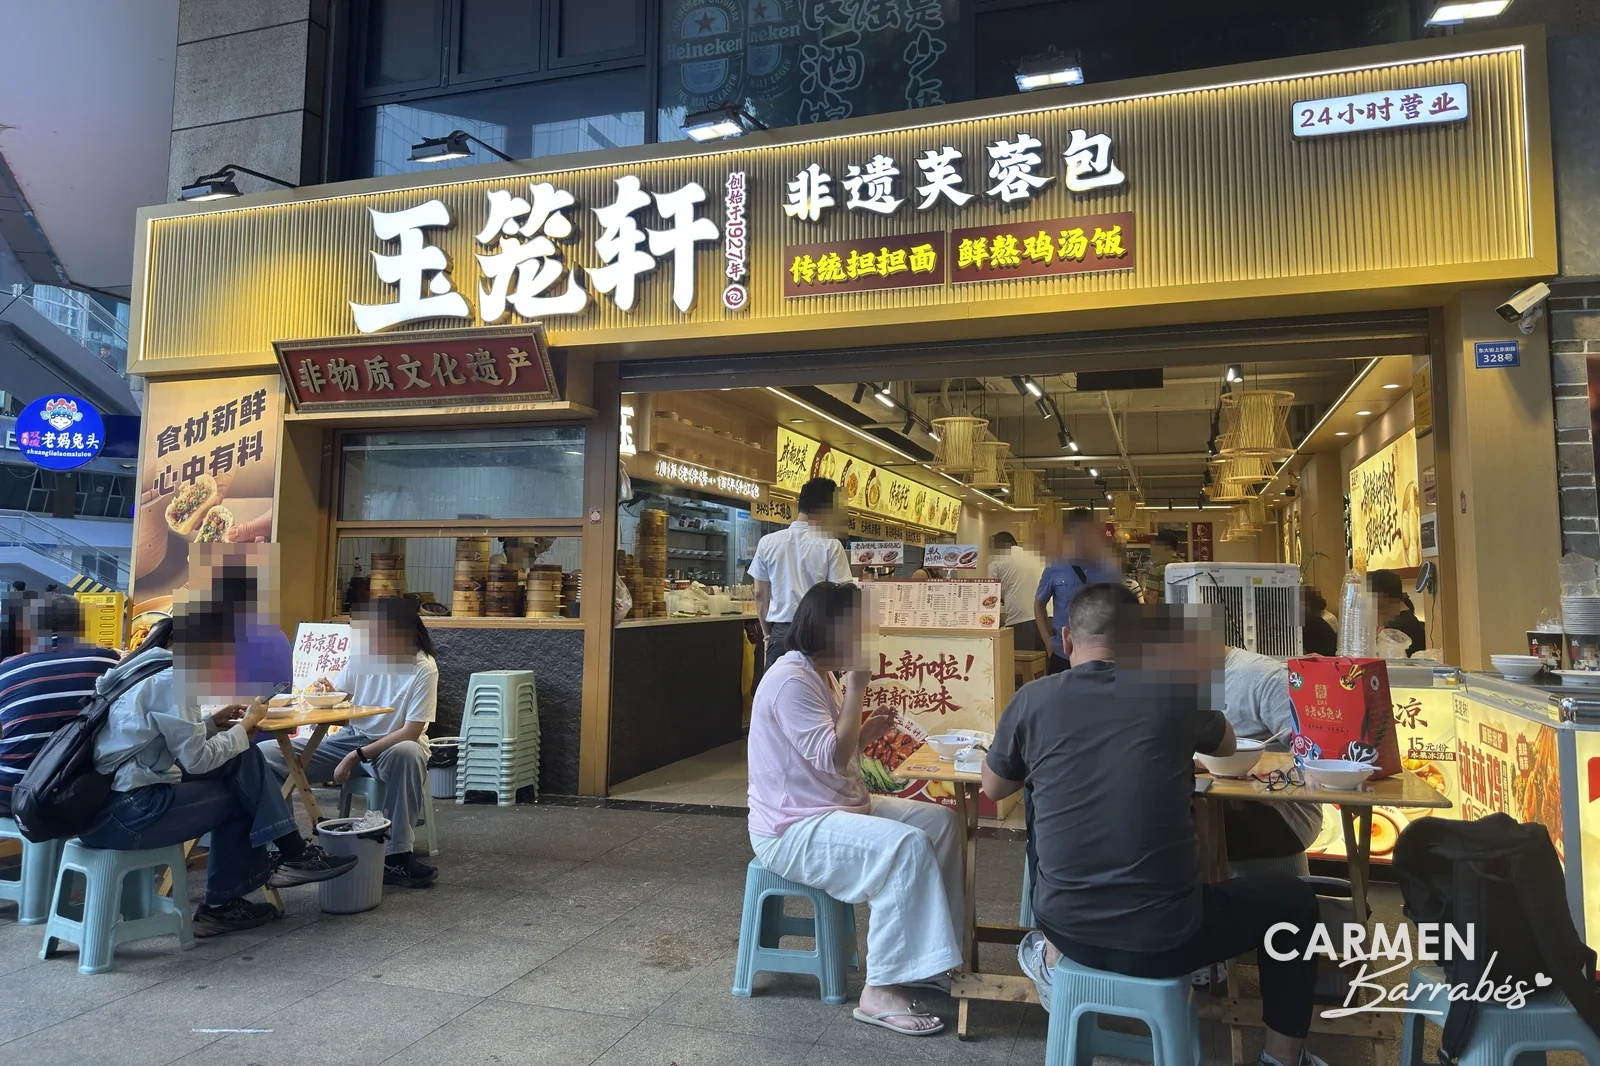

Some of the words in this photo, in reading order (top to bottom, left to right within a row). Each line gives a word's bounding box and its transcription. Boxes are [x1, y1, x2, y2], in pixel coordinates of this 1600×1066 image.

[665, 37, 743, 60] Heineken
[1299, 91, 1460, 129] 24小时营业
[783, 127, 1127, 222] 非遗芙蓉包
[725, 171, 747, 281] 创始于1927年
[957, 223, 1128, 269] 鲜熬鸡汤饭
[789, 242, 938, 287] 传统担担面
[297, 346, 533, 396] 非物质文化遗产
[1483, 353, 1514, 364] 328号
[41, 431, 100, 449] 老妈兔头
[156, 388, 268, 460] 食材新鲜
[151, 429, 264, 497] 心中有料
[298, 631, 349, 655] 清凉夏日
[1393, 697, 1429, 730] 凉
[1407, 736, 1450, 752] 15元/份
